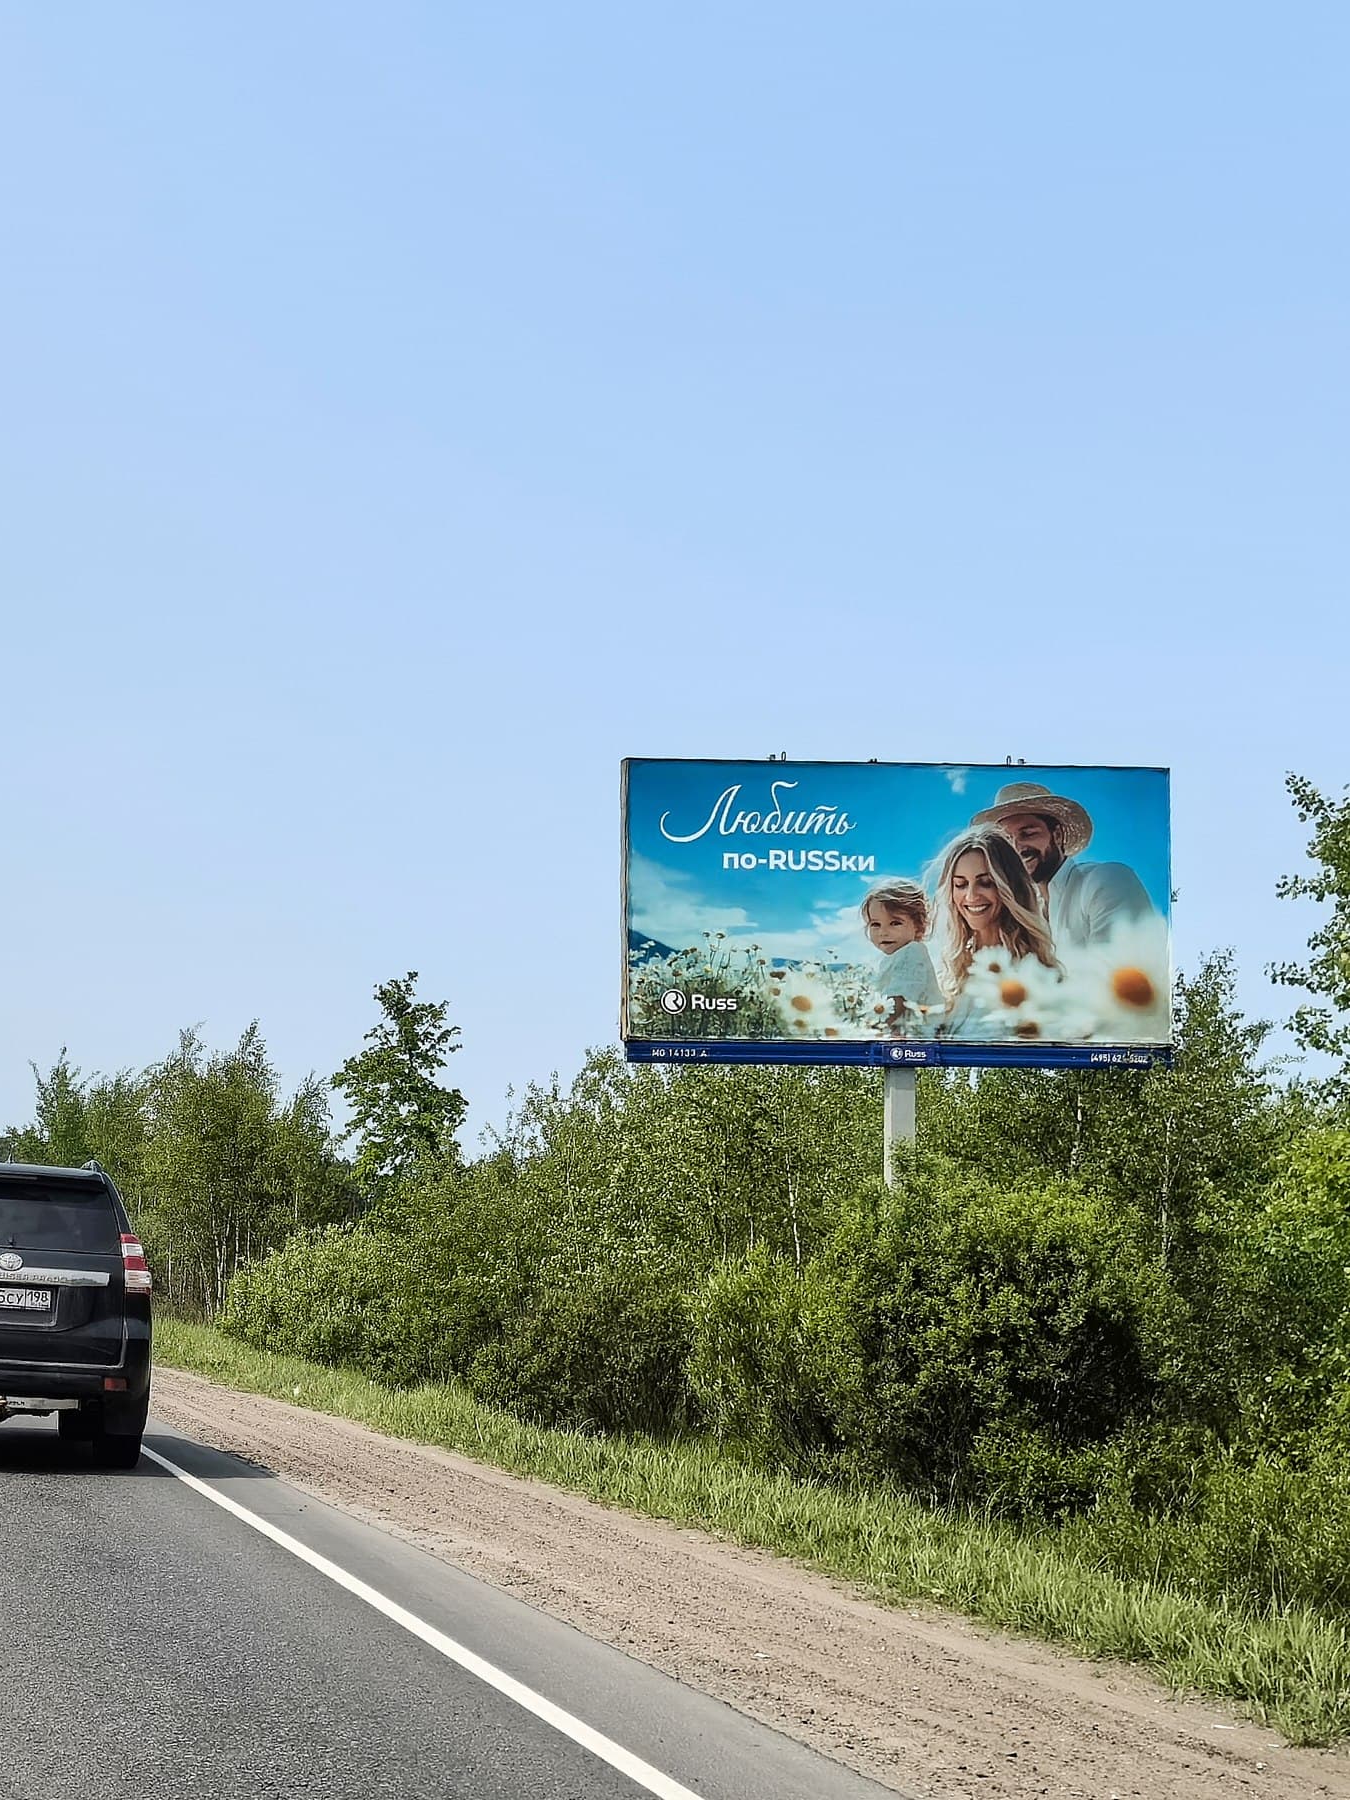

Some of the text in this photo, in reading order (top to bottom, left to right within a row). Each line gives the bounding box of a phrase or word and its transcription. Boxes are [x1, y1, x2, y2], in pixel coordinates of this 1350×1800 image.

[659, 781, 858, 843] Любить
[722, 849, 876, 872] по-RUSSки
[691, 993, 738, 1011] Russ
[904, 1049, 928, 1058] Russ
